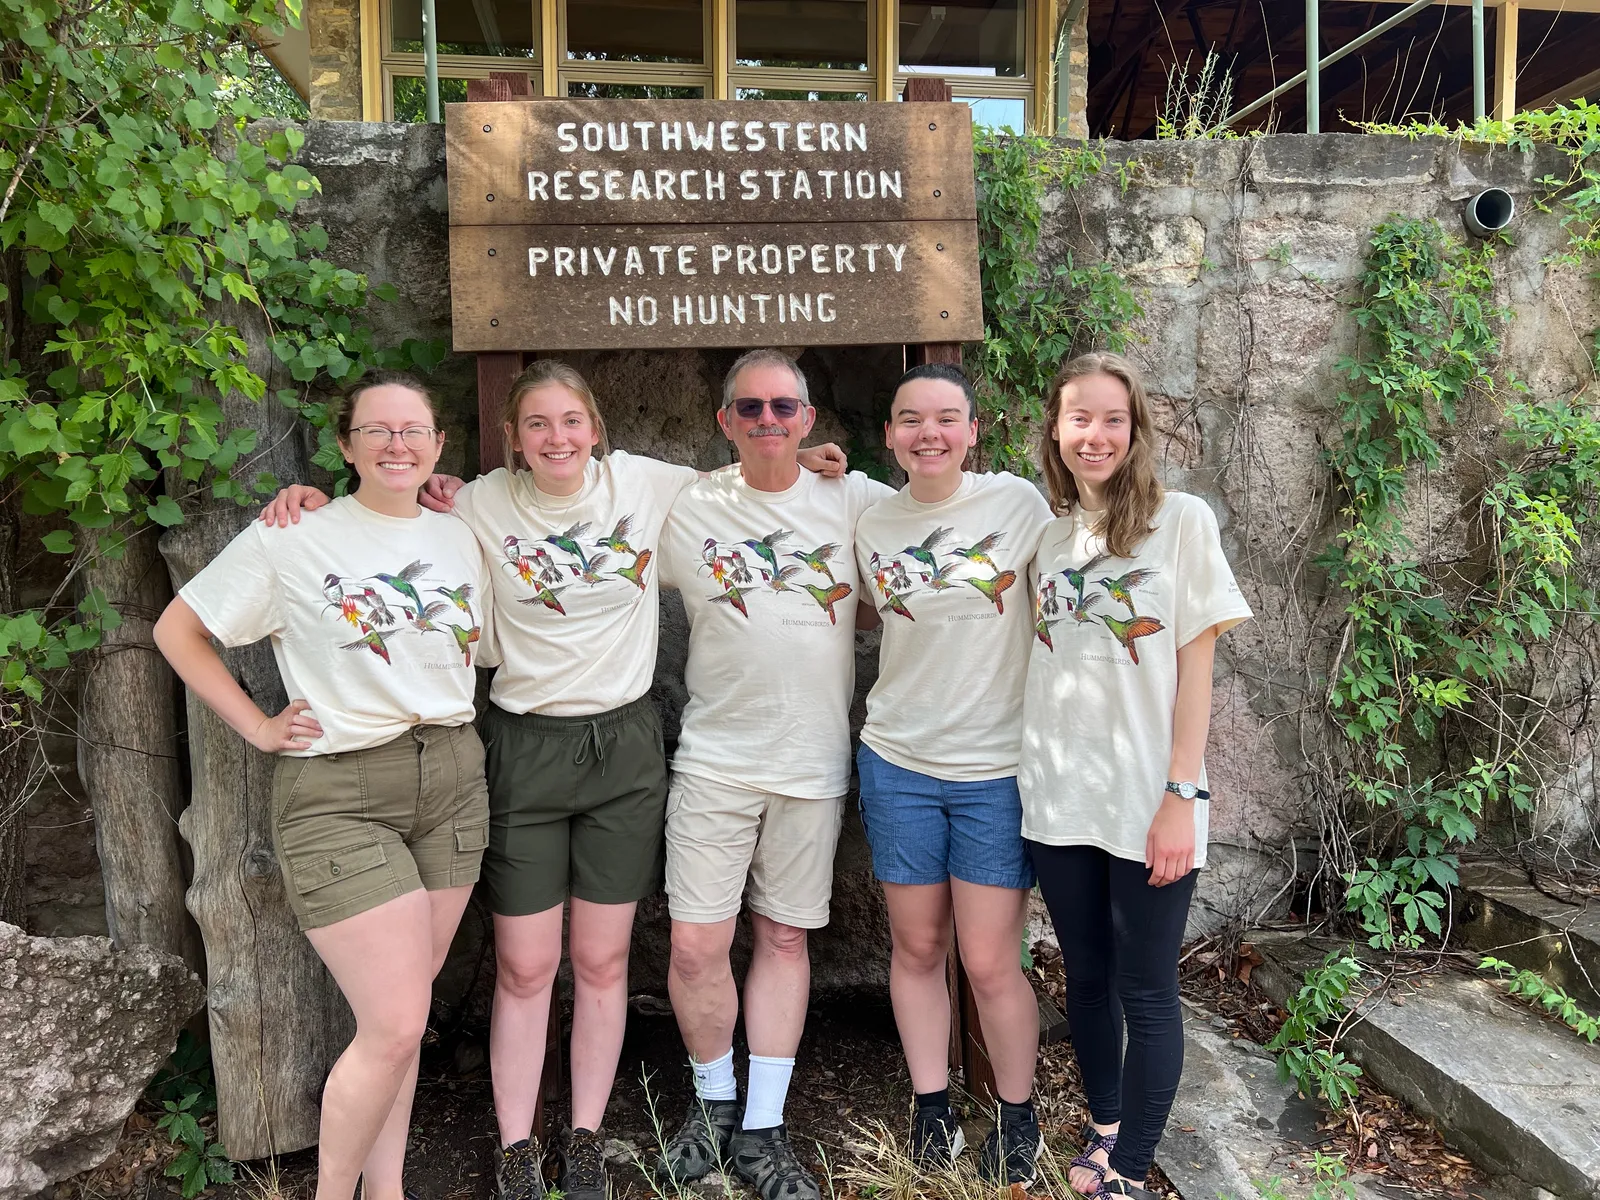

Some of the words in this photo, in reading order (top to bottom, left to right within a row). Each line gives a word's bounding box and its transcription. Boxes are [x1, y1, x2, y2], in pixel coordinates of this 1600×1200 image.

[557, 121, 867, 152] SOUTHWESTERN
[526, 169, 727, 202] RESEARCH
[739, 168, 902, 201] STATION
[528, 245, 698, 276] PRIVATE
[711, 243, 908, 275] PROPERTY
[608, 295, 658, 326] NO
[671, 292, 836, 325] HUNTING
[781, 617, 830, 628] HUMMINGBIRDS
[948, 613, 998, 623] HUMMINGBIRDS
[1080, 653, 1131, 666] HUMMINGBIRDS
